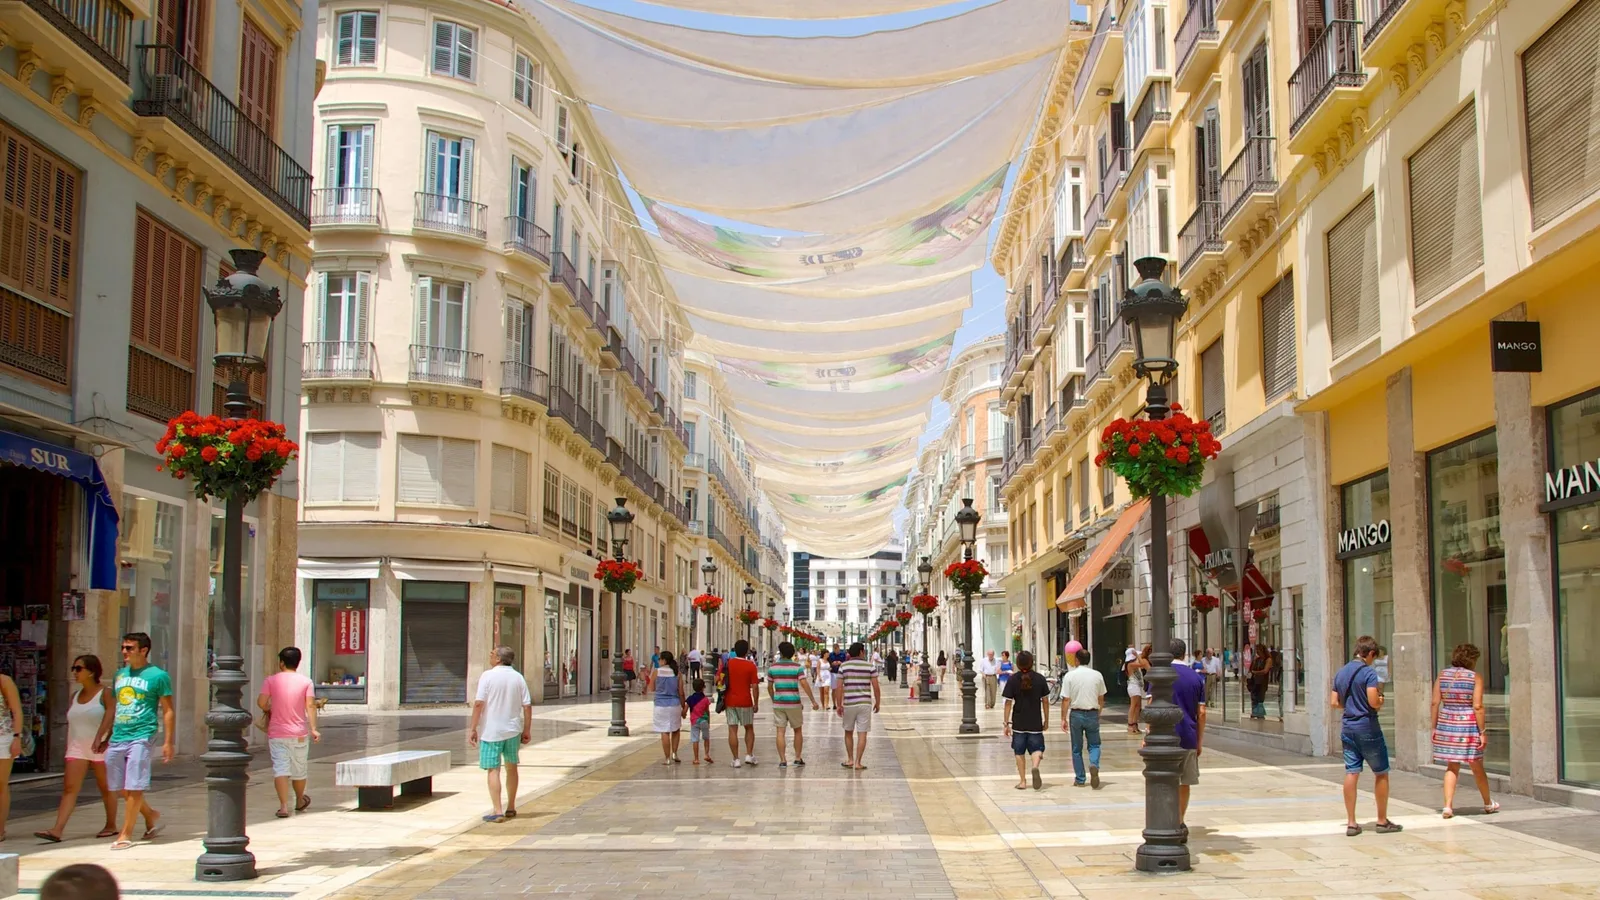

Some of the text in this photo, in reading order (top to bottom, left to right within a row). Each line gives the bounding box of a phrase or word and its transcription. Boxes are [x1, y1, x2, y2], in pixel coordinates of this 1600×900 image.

[1497, 342, 1537, 350] MANGO
[31, 447, 72, 472] SUR
[1338, 519, 1390, 554] MANGO
